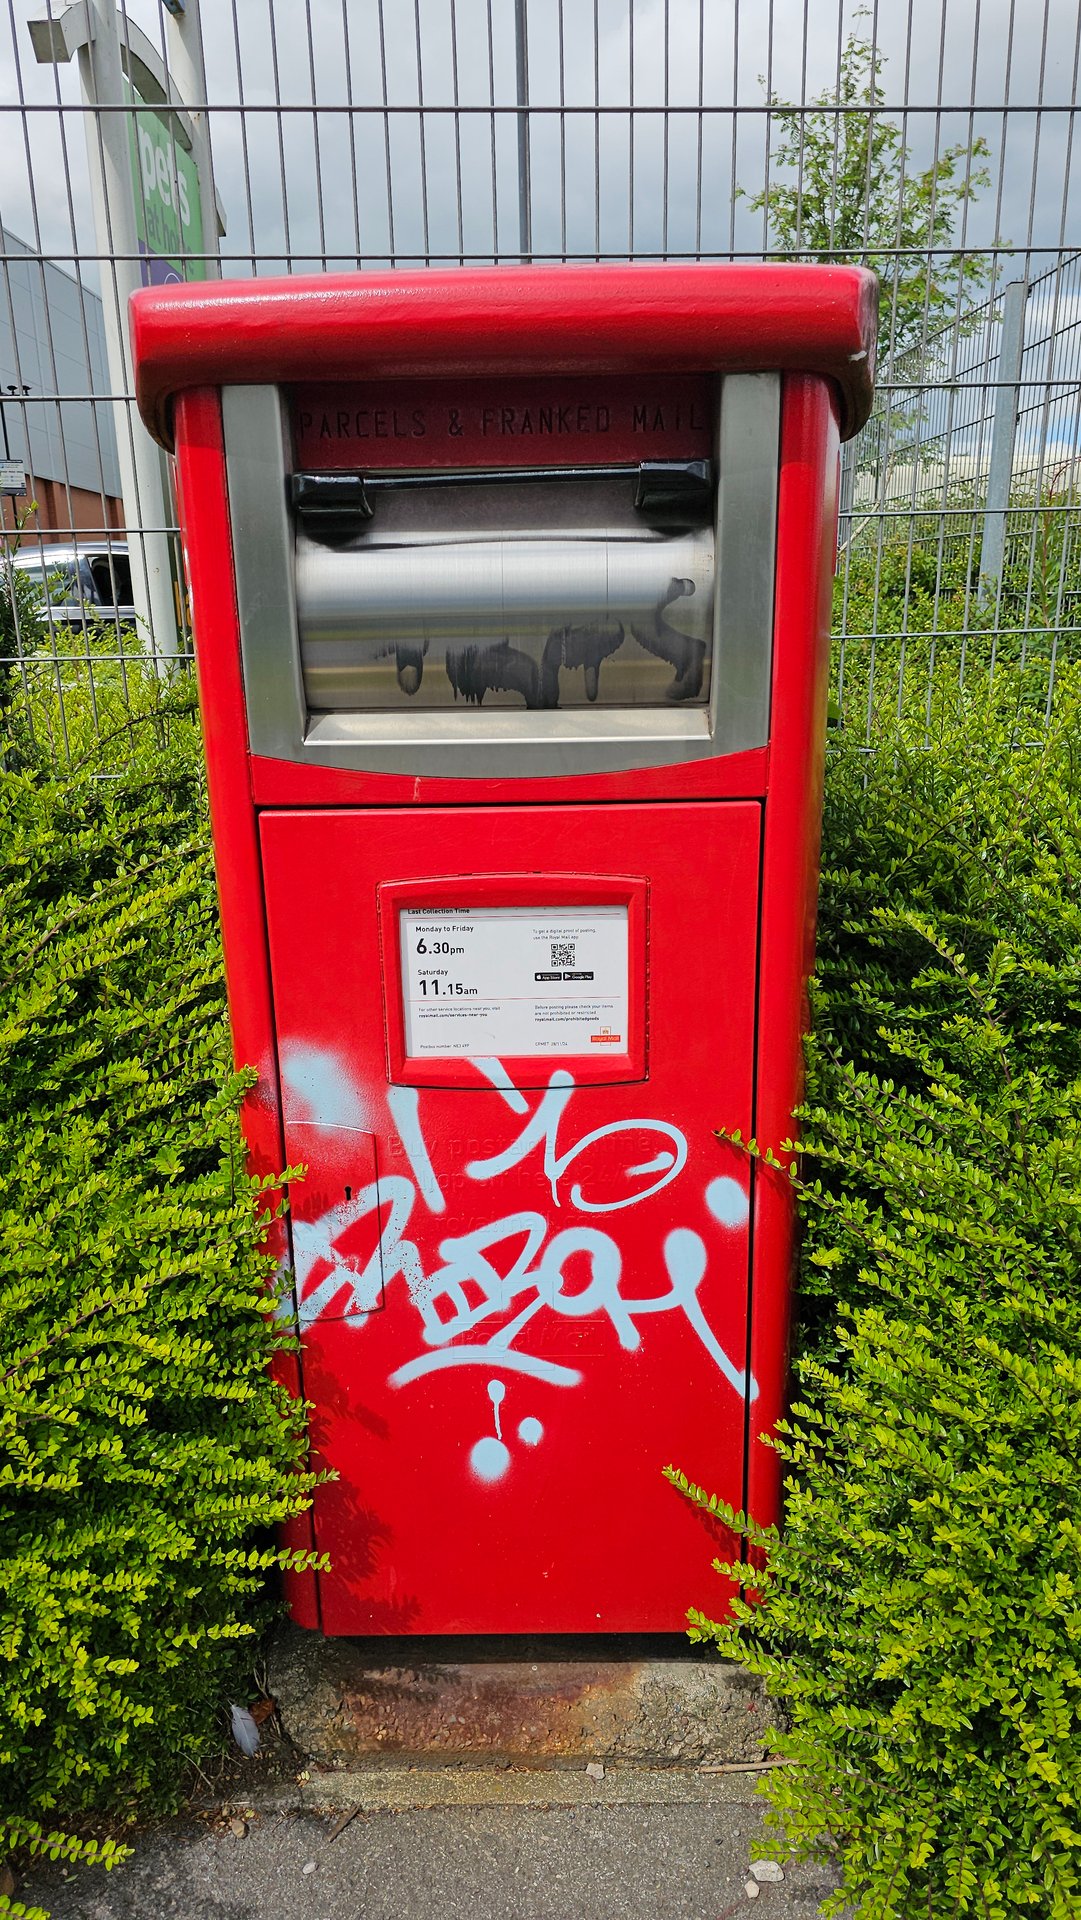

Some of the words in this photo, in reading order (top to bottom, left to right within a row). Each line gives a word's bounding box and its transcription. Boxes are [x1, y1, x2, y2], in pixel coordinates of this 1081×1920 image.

[139, 125, 191, 227] pets
[147, 204, 161, 246] at
[299, 409, 427, 440] PARCELS
[448, 408, 464, 437] &
[482, 405, 611, 437] FRANKED
[632, 403, 704, 433] MAIL
[415, 926, 442, 934] Monday
[452, 925, 474, 933] Friday
[416, 937, 465, 955] 6.30pm
[417, 969, 449, 977] Saturday
[419, 979, 478, 996] 11.15am
[387, 1135, 438, 1158] Buy
